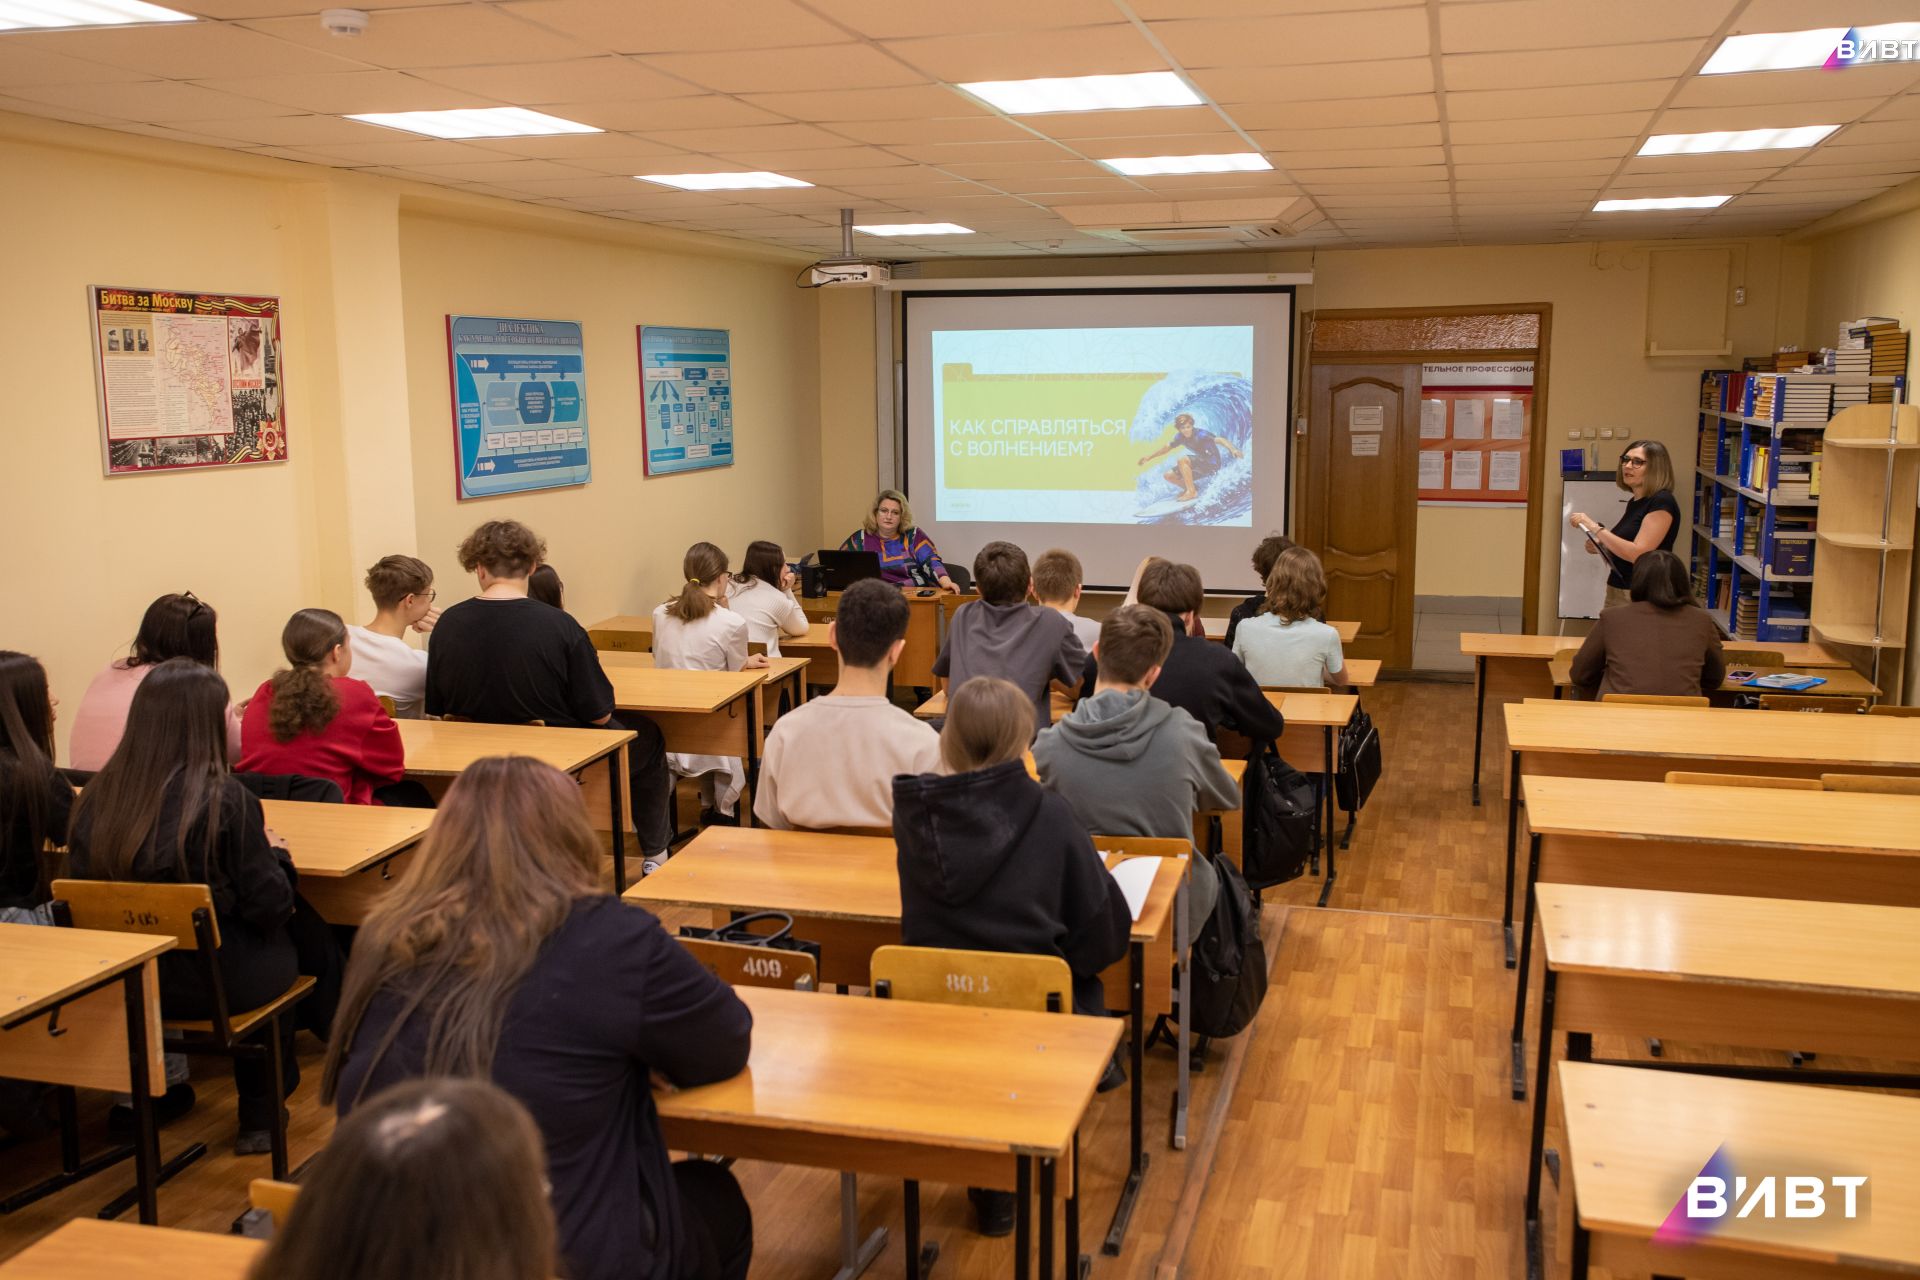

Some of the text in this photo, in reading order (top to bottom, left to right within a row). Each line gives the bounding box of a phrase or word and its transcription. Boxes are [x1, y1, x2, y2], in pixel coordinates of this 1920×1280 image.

[101, 290, 193, 312] Битва за Москву
[949, 418, 1127, 436] КАК СПРАВЛЯТЬСЯ
[950, 440, 1094, 456] С ВОЛНЕНИЕМ?
[743, 957, 782, 978] 409
[946, 973, 990, 993] 803
